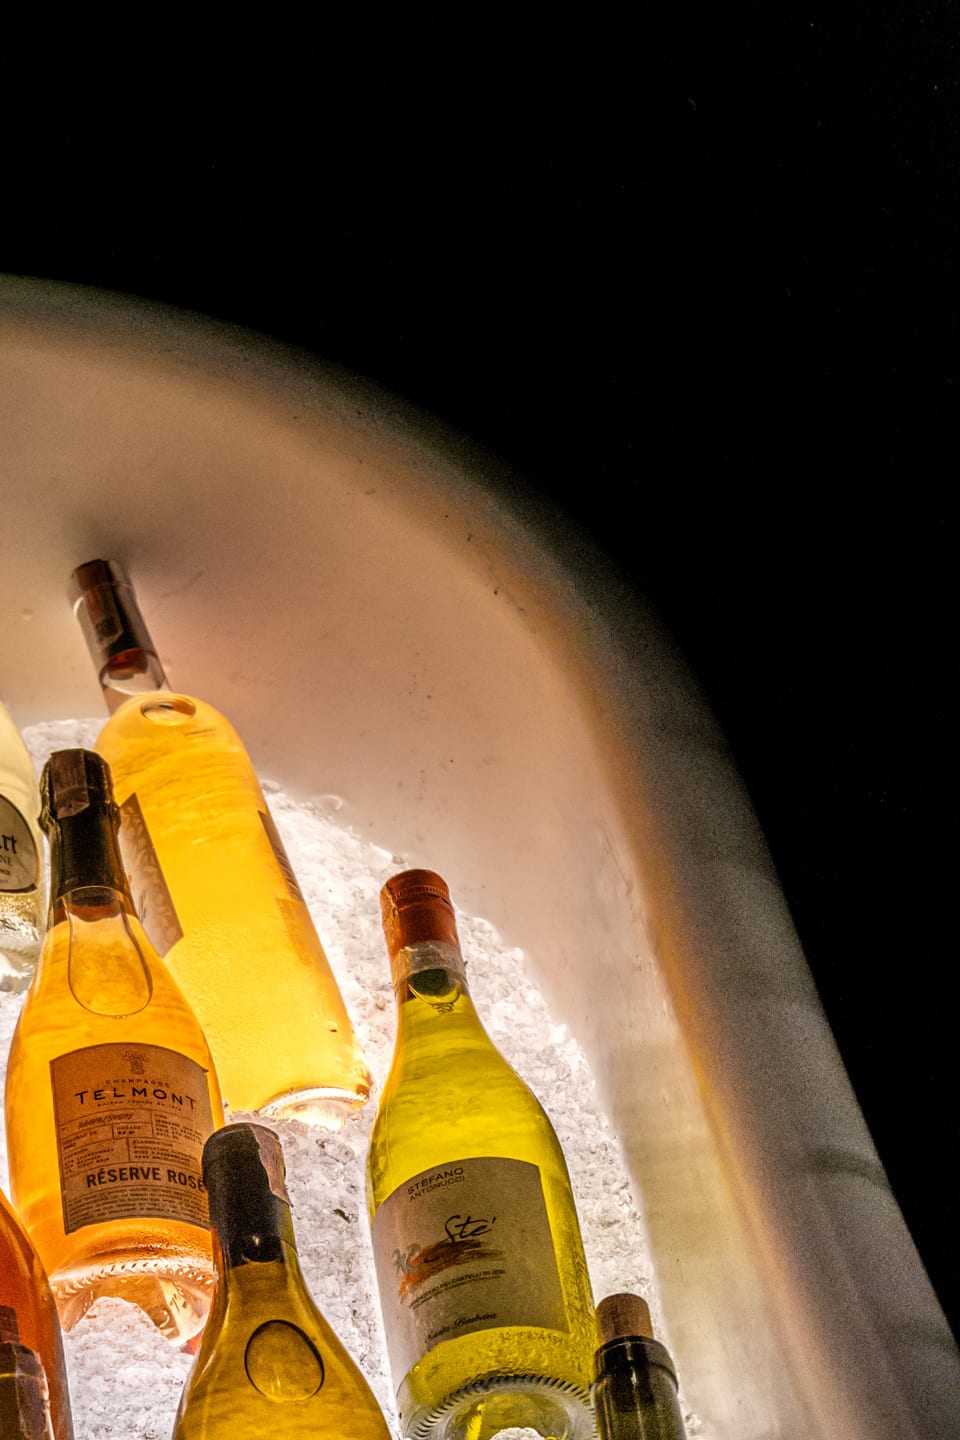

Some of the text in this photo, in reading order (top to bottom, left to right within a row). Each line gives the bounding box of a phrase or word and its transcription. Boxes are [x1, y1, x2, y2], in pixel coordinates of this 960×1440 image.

[75, 1087, 197, 1110] TELMONT
[86, 1166, 161, 1188] RÉSERVE
[407, 1167, 464, 1195] STEFANO
[409, 1176, 465, 1200] ANTONUCCI
